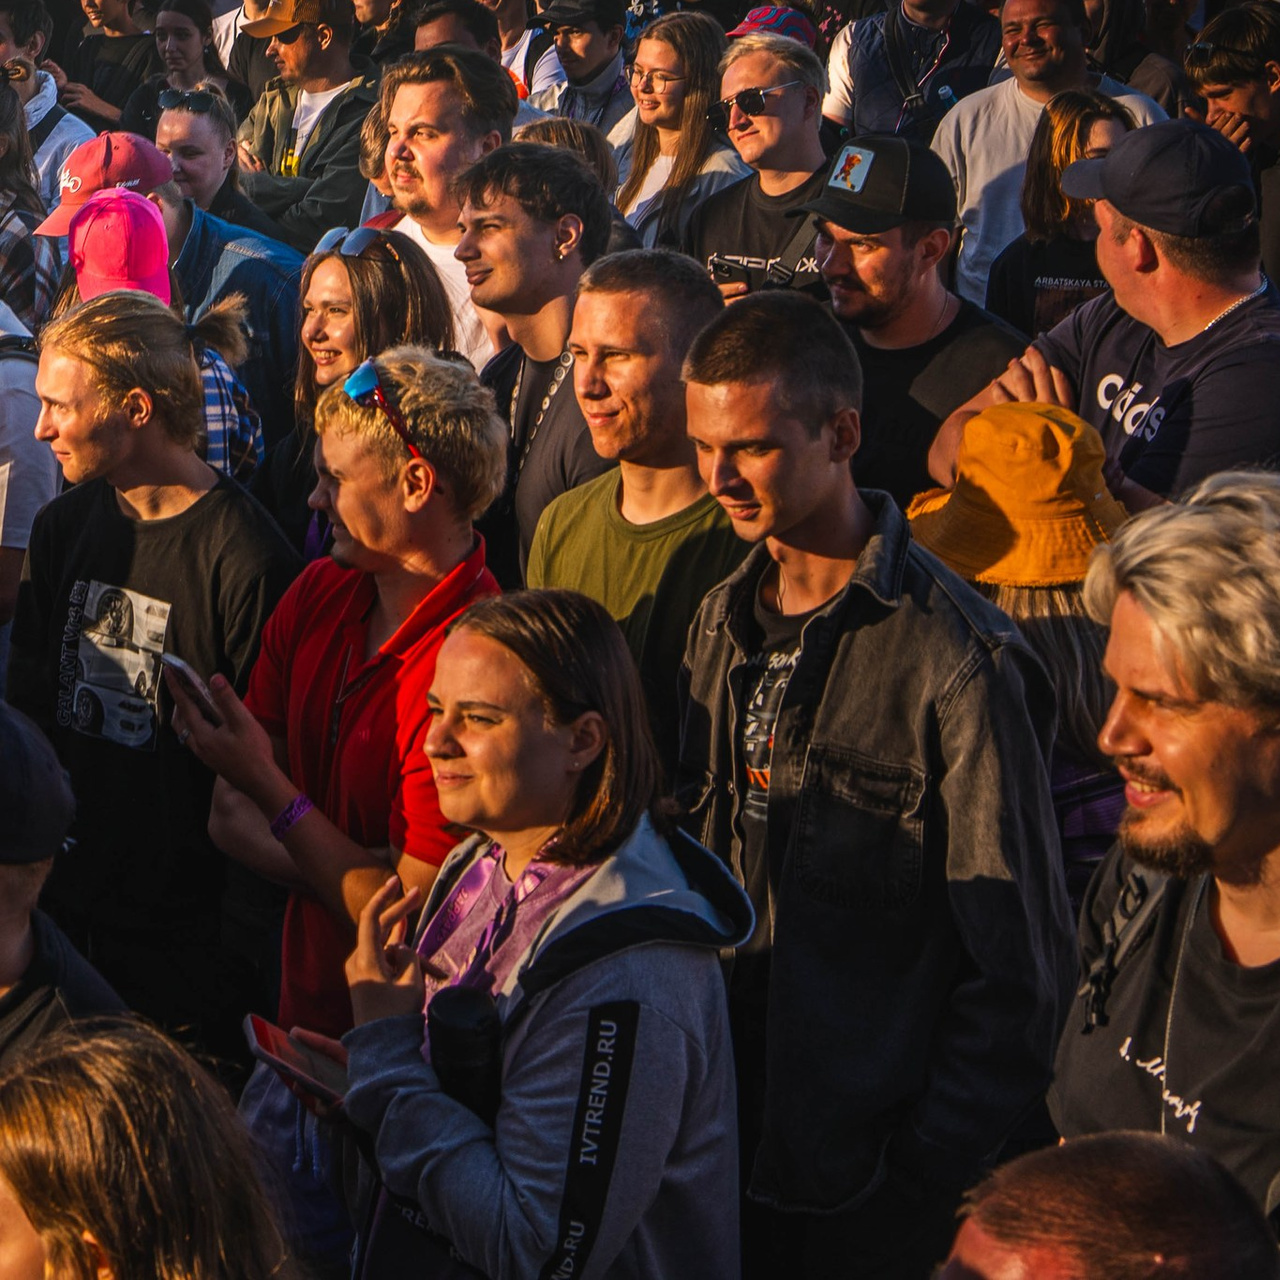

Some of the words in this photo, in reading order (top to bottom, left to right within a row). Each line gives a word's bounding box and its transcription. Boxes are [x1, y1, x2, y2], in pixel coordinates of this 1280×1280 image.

[1034, 276, 1092, 288] ARBATSKAYA
[1093, 279, 1110, 289] STA
[57, 642, 78, 727] GALANT
[579, 1020, 618, 1166] IVTREND.RU
